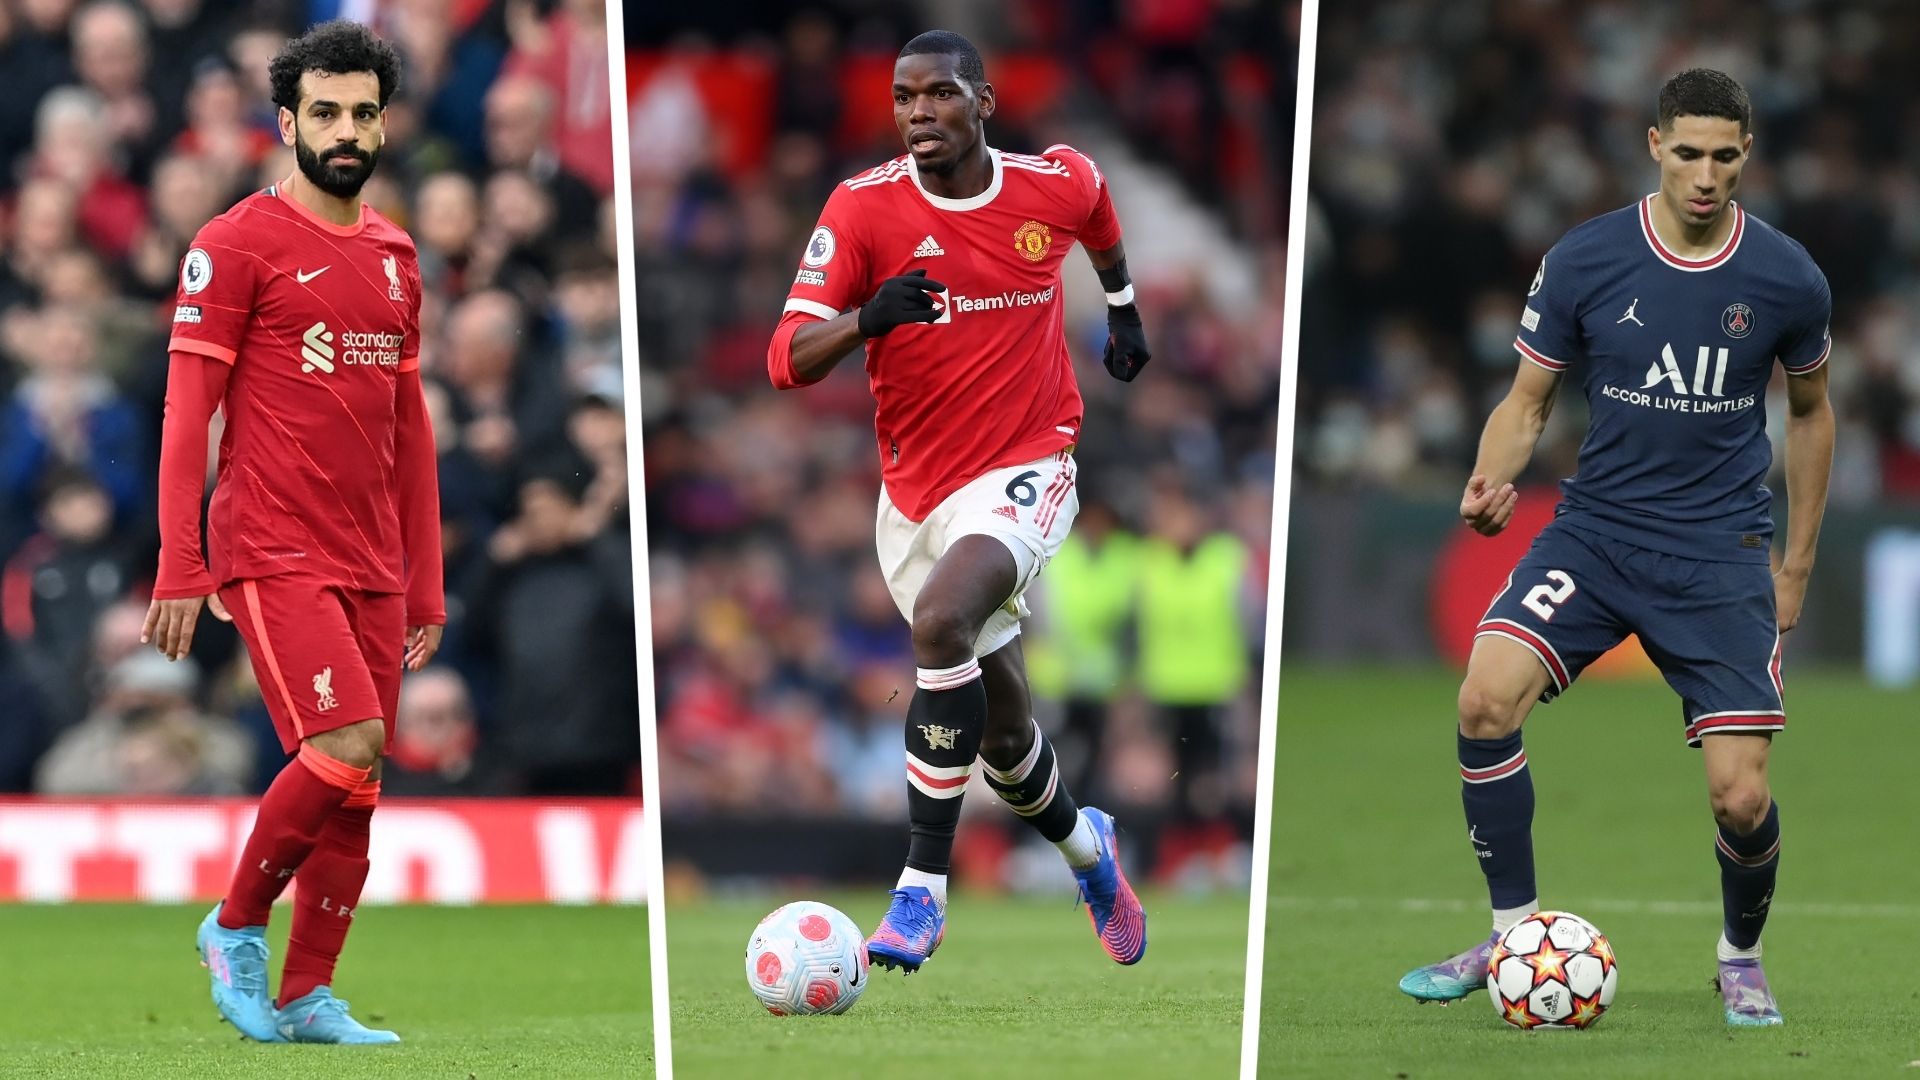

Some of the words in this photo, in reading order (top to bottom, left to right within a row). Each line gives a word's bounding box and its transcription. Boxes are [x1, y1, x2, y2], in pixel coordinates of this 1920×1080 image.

[914, 247, 945, 257] adidas
[388, 289, 405, 302] LFC
[952, 286, 1055, 313] TeamViewer
[1728, 305, 1750, 315] PARIS
[1602, 384, 1651, 408] ACCOR
[1655, 396, 1690, 413] LIVE
[1694, 394, 1755, 413] LIMITLESS
[1005, 470, 1042, 507] 6
[991, 509, 1020, 525] adidas
[1521, 569, 1577, 623] 2
[317, 699, 340, 712] LFC
[1550, 991, 1561, 1016] adidas
